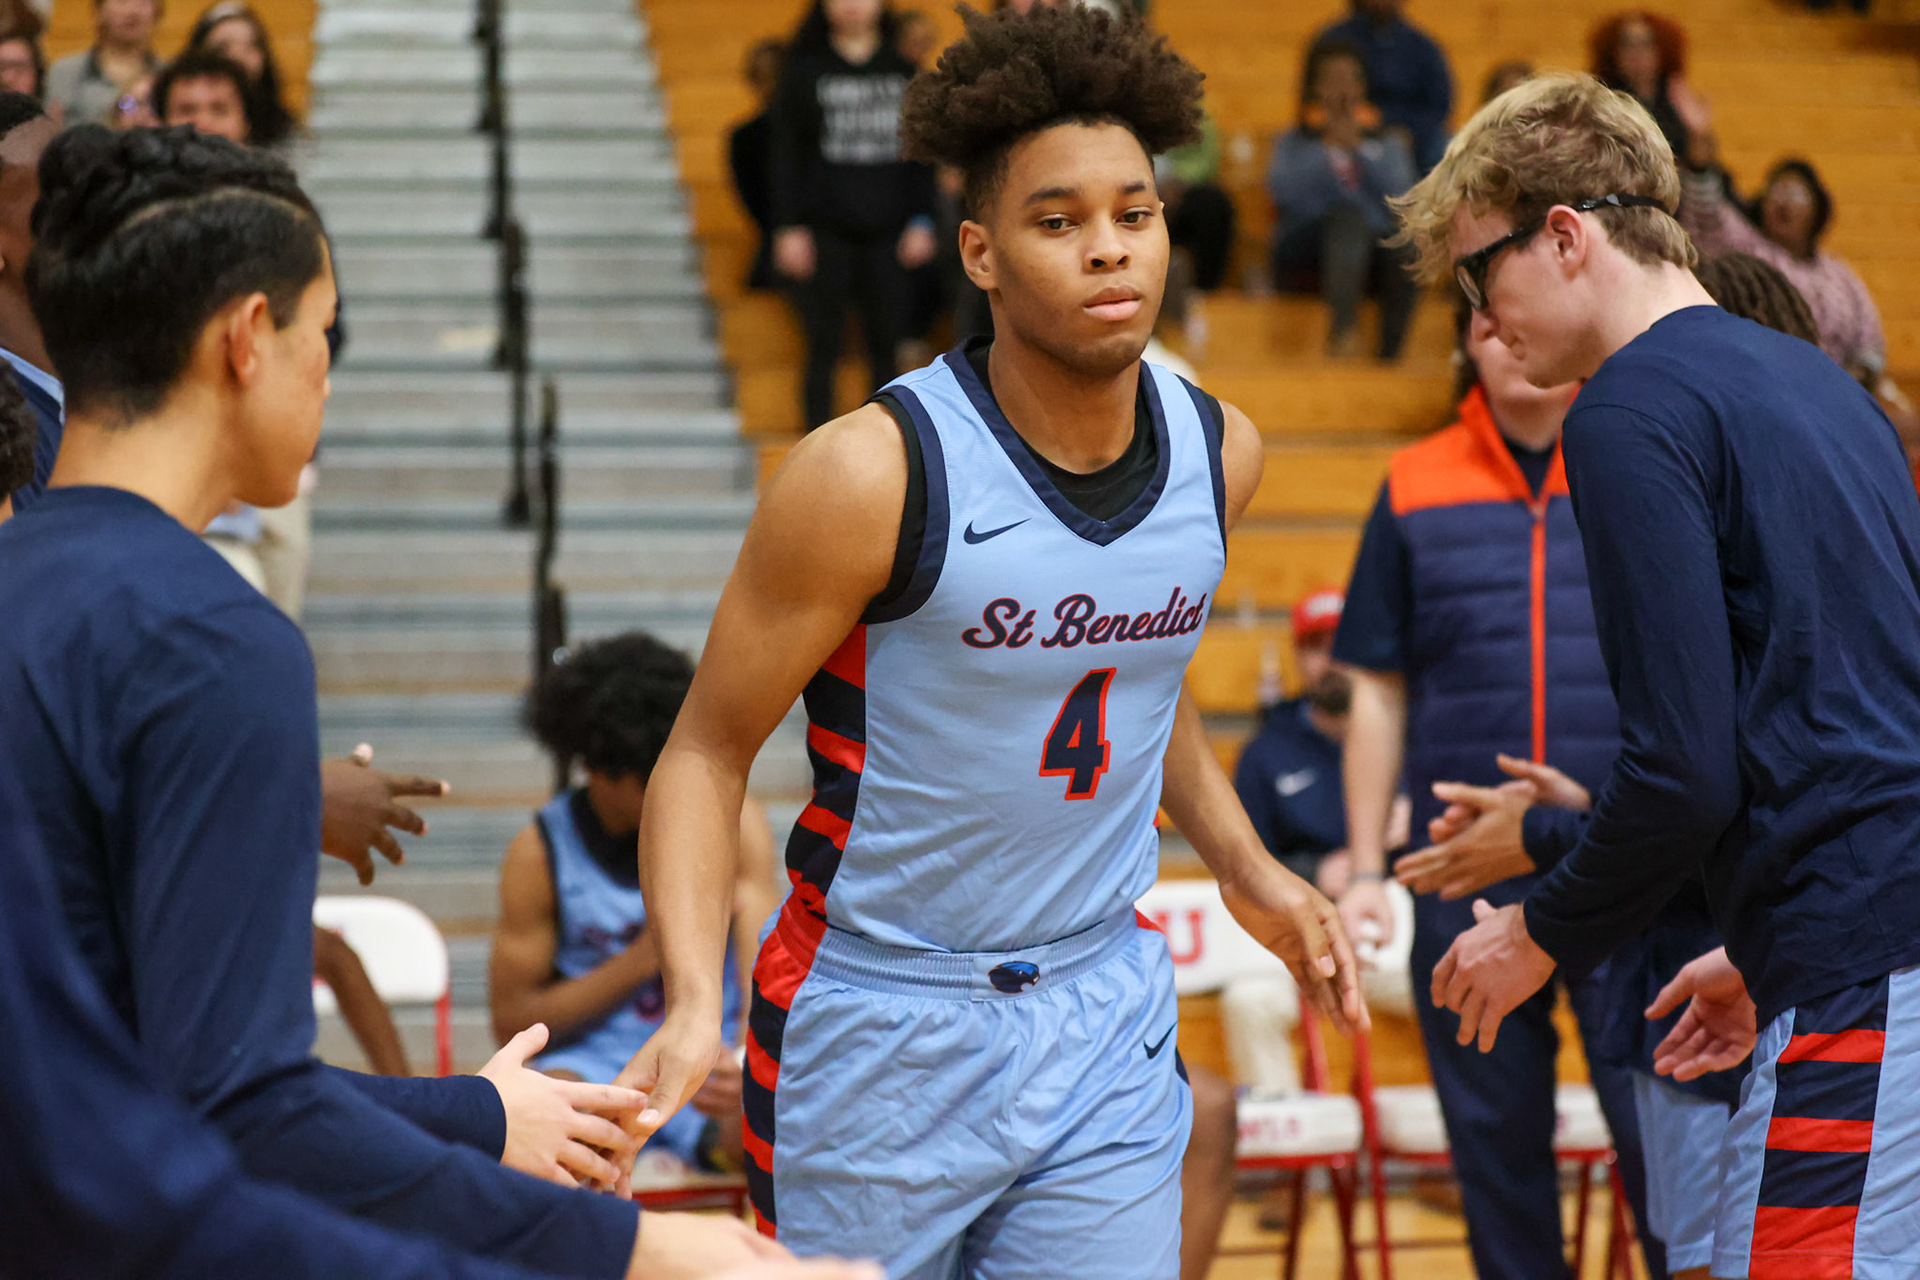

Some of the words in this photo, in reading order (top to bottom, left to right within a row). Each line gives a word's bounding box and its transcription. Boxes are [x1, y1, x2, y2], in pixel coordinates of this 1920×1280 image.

[961, 597, 1036, 649] St
[1040, 586, 1207, 648] Benedict
[1039, 667, 1117, 800] 4
